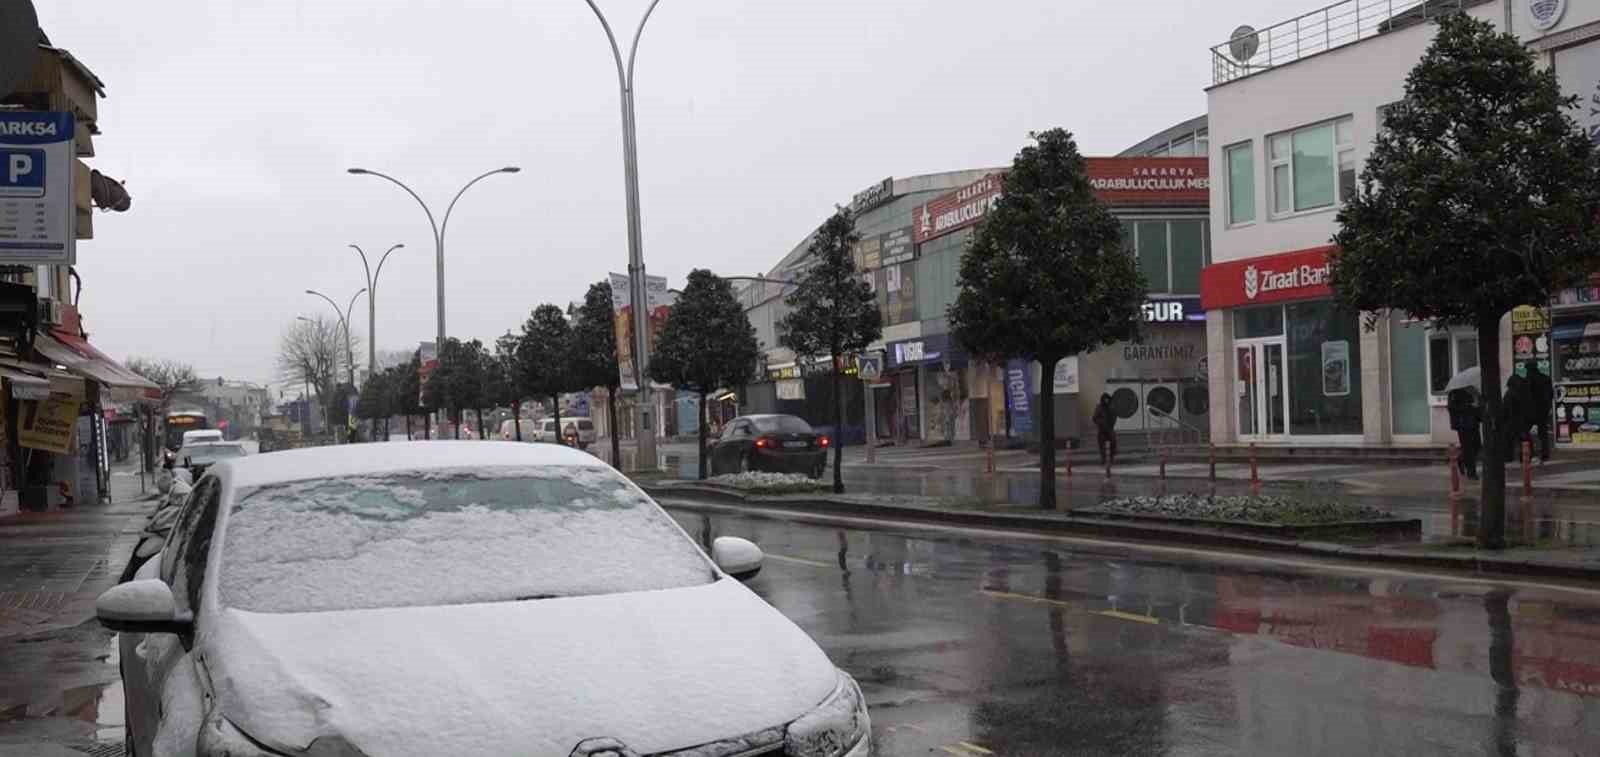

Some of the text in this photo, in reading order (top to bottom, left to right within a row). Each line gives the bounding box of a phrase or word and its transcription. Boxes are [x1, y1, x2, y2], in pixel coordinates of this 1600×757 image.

[9, 153, 33, 183] P
[1132, 166, 1195, 177] SAKARYA
[1260, 266, 1299, 292] Ziraat
